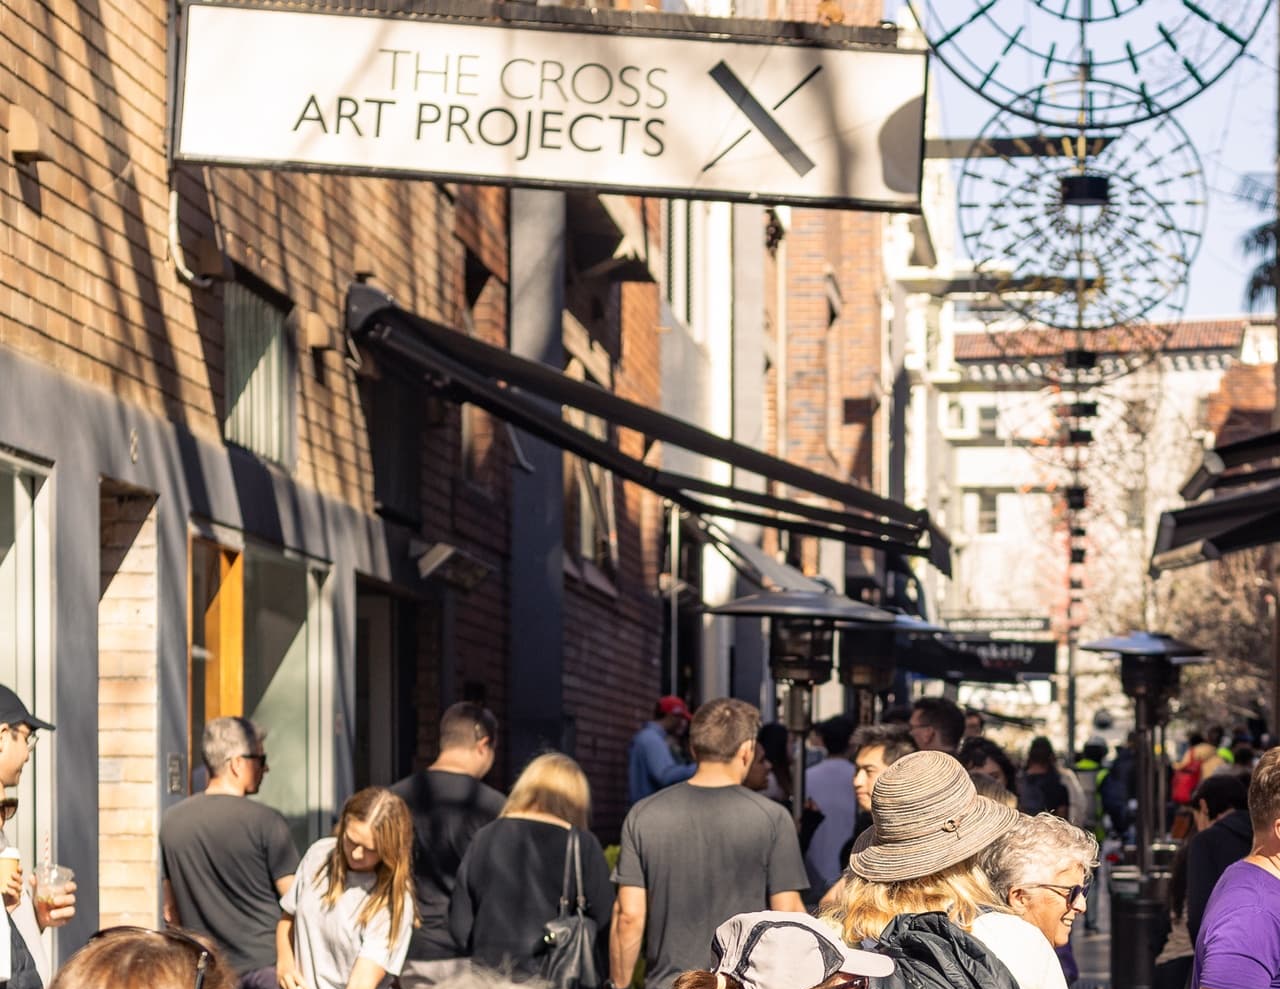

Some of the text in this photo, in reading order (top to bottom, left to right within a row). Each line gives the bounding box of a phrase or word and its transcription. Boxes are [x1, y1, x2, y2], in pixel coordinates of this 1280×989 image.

[378, 48, 668, 110] THE CROSS
[293, 94, 666, 161] ART PROJECTS
